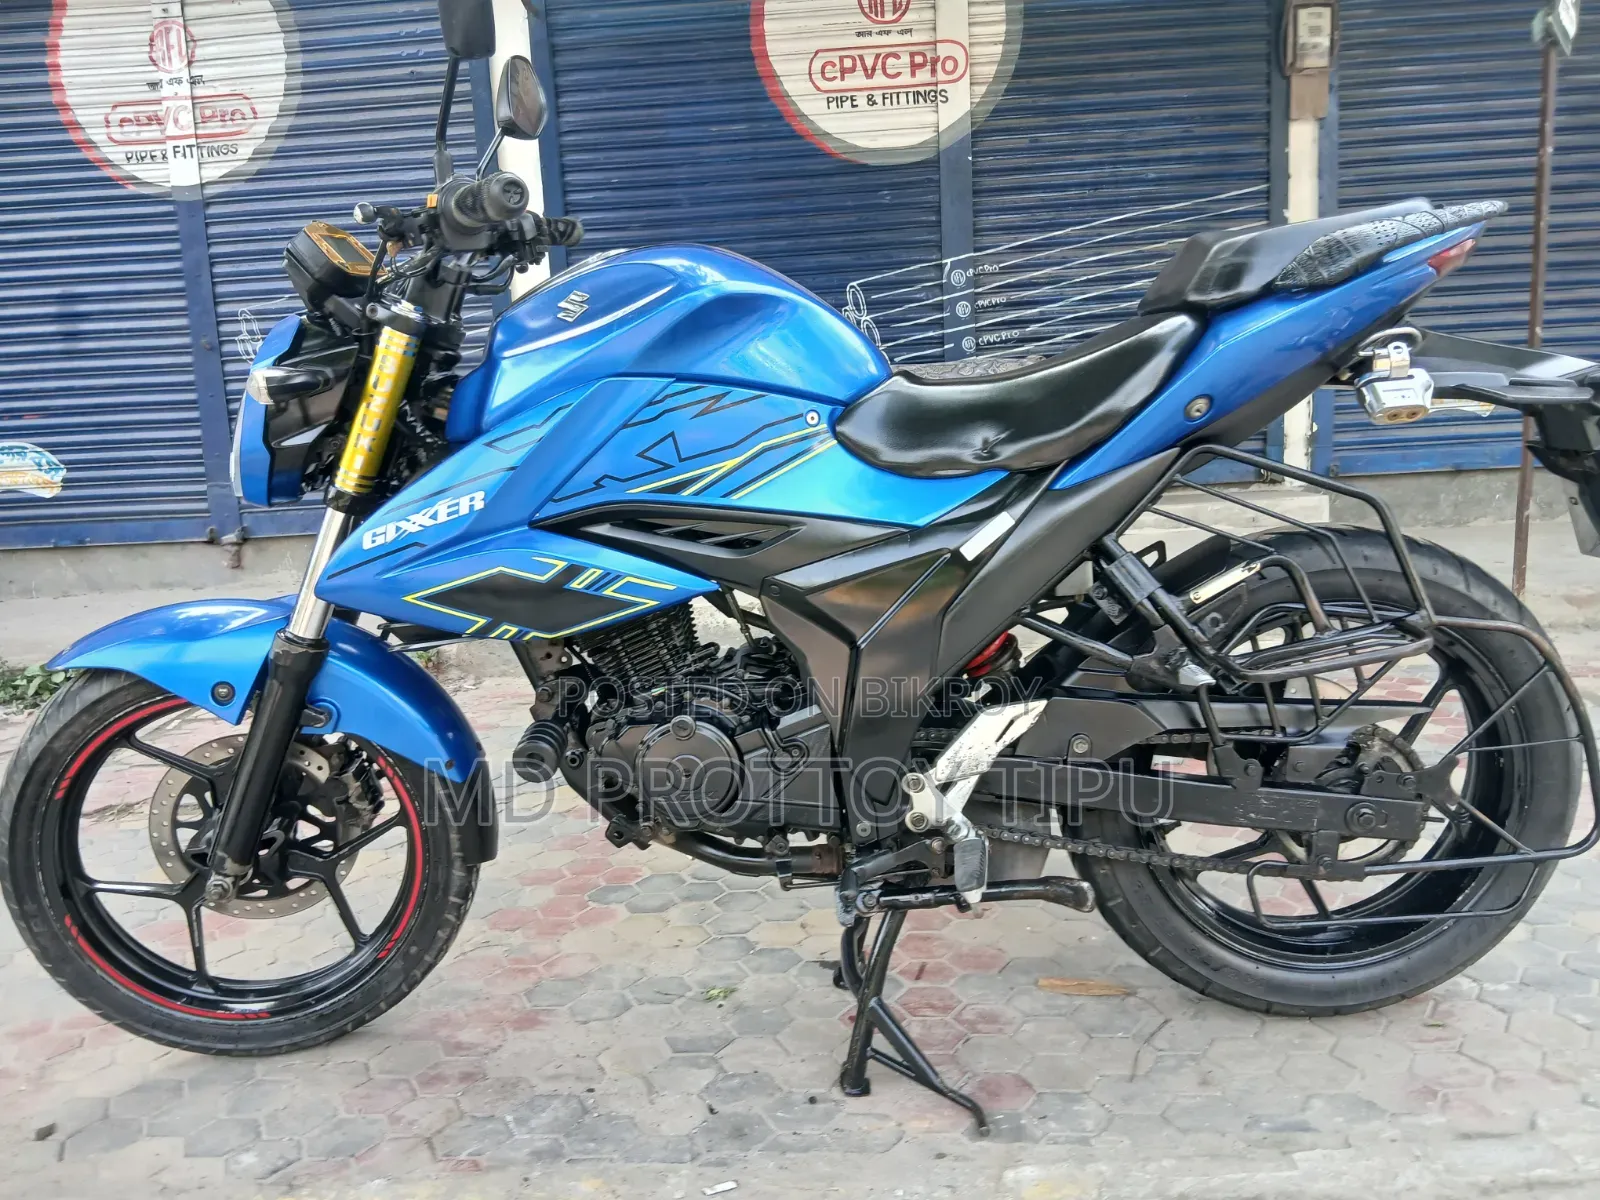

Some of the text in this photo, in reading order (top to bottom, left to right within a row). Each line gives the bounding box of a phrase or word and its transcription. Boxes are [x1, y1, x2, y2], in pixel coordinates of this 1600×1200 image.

[820, 51, 959, 82] cPVC Pro
[826, 89, 949, 110] PIPE & FITTINGS
[172, 143, 239, 160] FITTINGS
[362, 490, 486, 550] GIXXER
